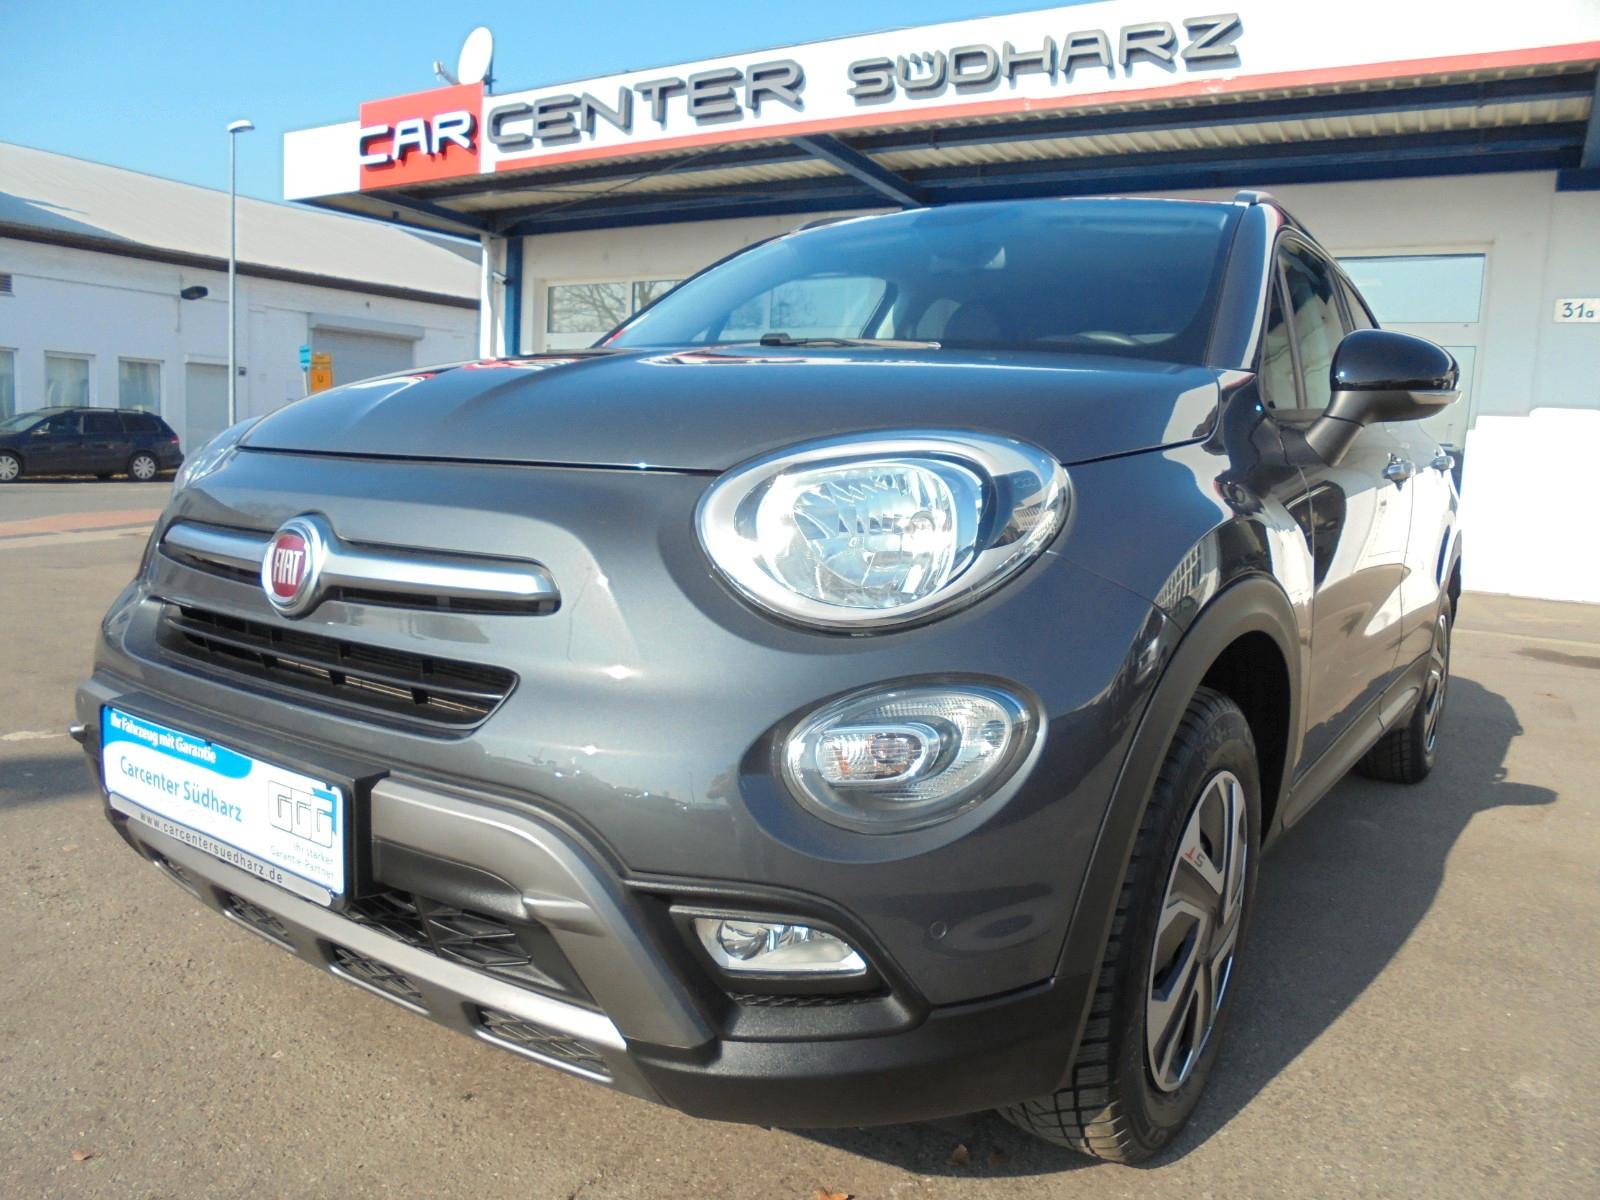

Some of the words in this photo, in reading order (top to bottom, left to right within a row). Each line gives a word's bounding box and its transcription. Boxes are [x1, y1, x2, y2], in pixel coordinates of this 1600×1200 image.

[847, 13, 1242, 104] SÜDHARZ
[1562, 302, 1594, 318] 31a
[273, 548, 304, 586] FIAT
[121, 717, 159, 747] Fahrzeug
[159, 733, 176, 750] mit
[175, 737, 217, 764] Garantie
[120, 755, 180, 796] Carcenter
[183, 780, 243, 823] Südharz
[139, 812, 283, 883] www.carcentersuedharz.de
